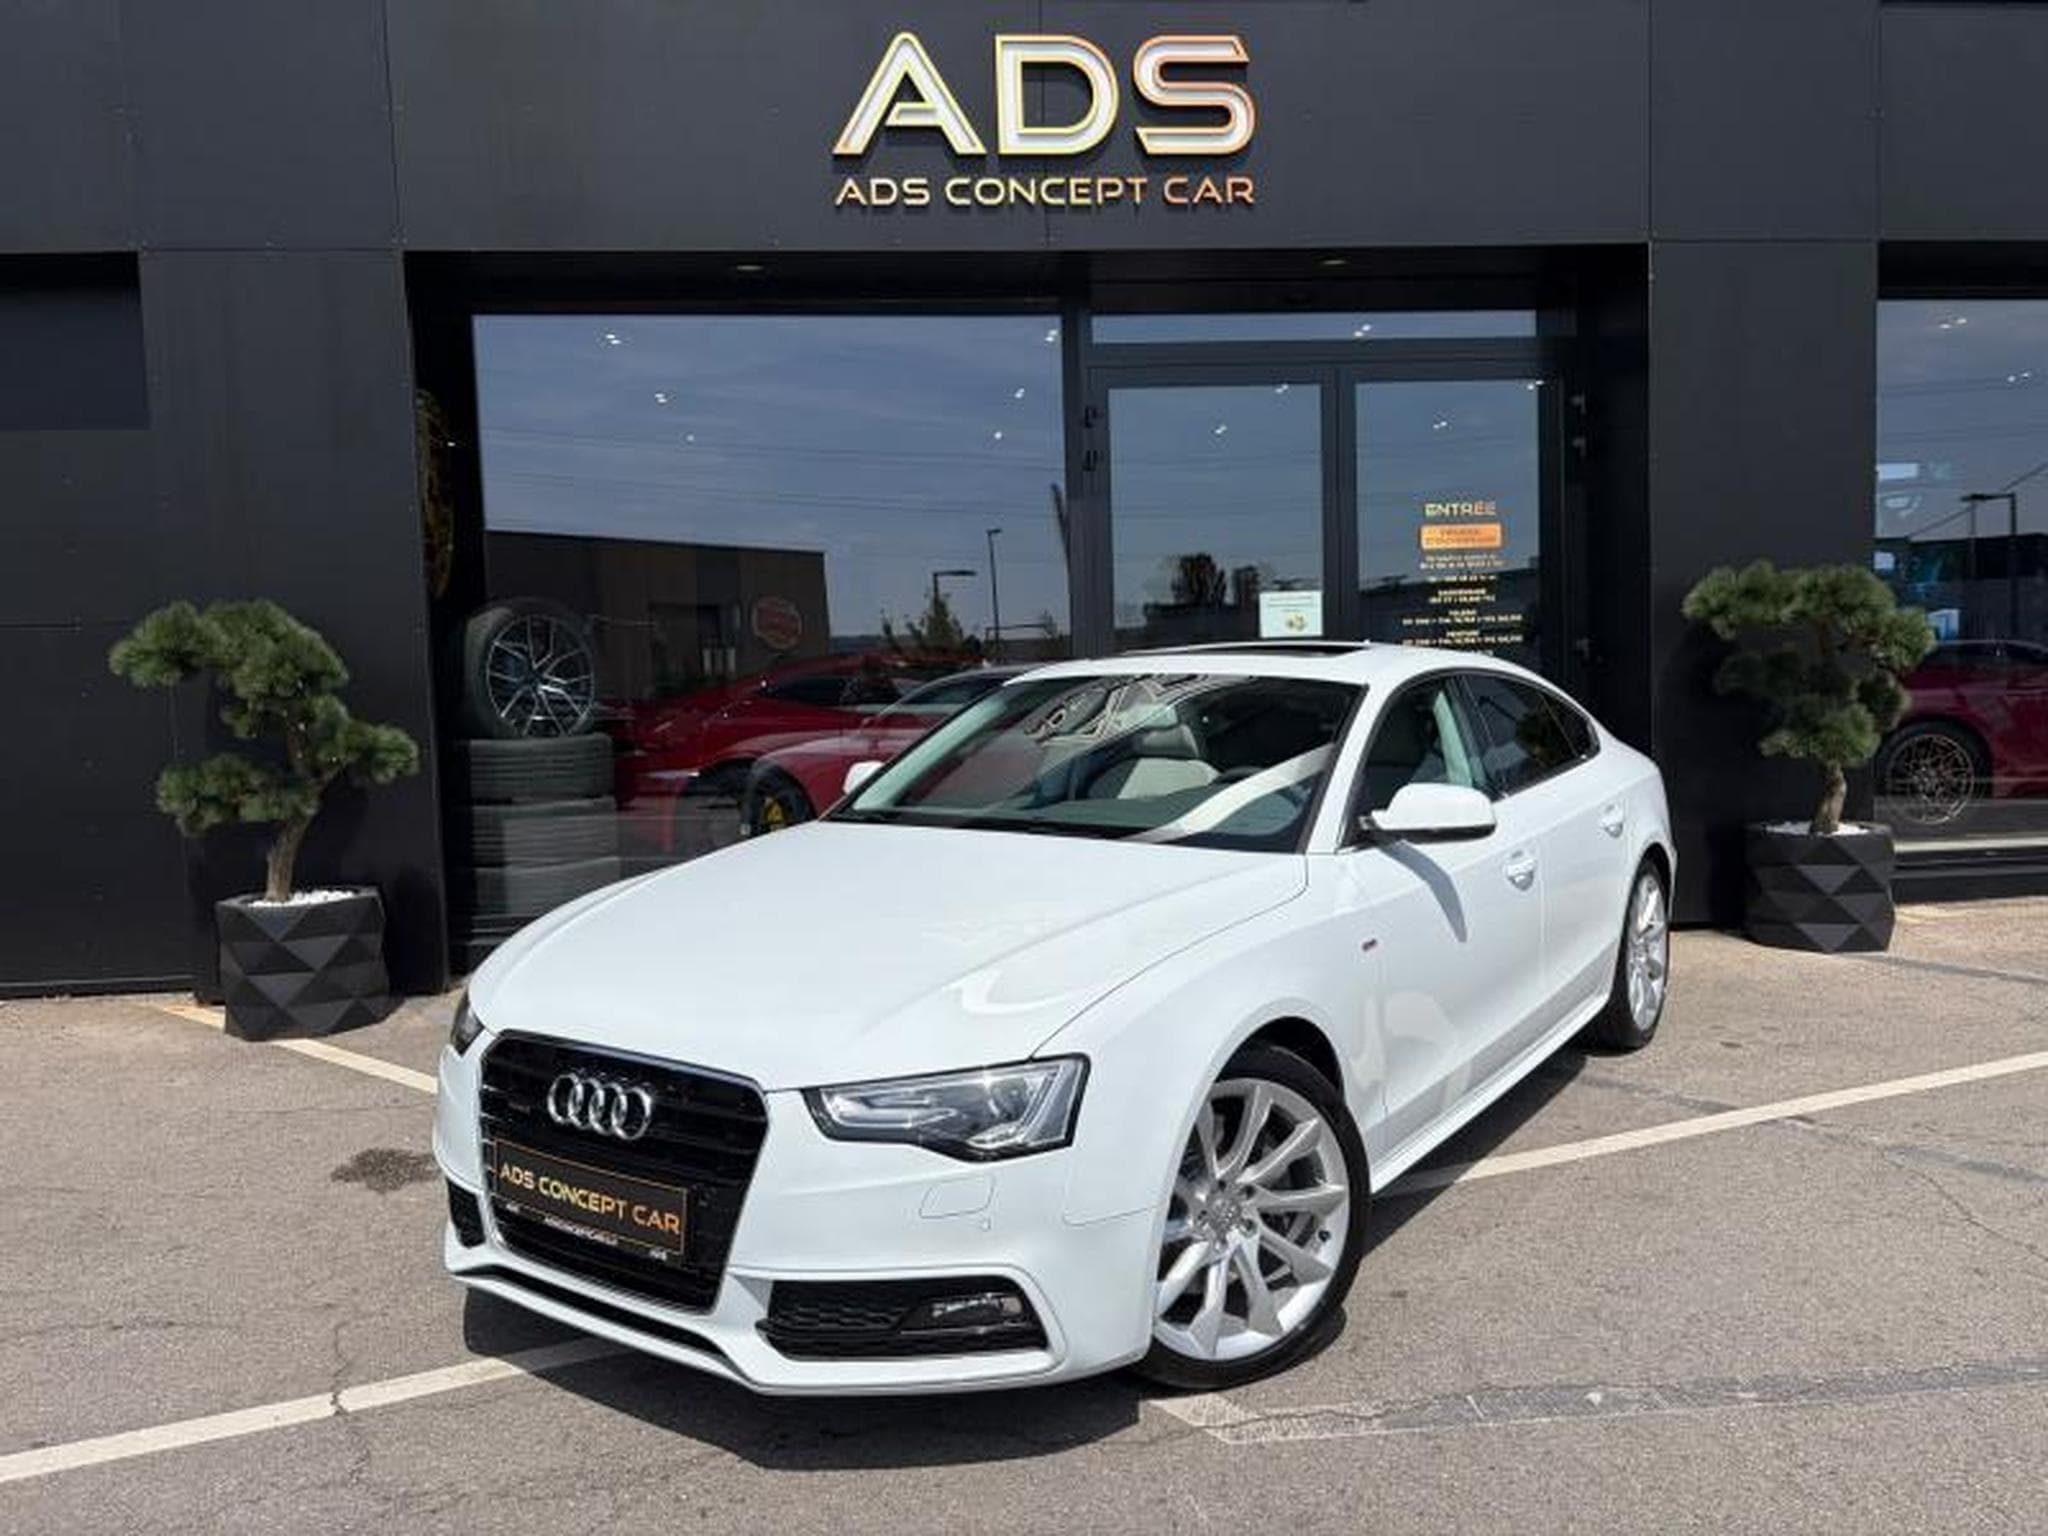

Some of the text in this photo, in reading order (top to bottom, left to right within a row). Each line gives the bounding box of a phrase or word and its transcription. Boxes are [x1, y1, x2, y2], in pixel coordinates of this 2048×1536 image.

[832, 32, 1256, 155] ADS
[834, 175, 1256, 206] ADS CONCEPT CAR
[500, 1161, 535, 1190] ADS
[538, 1176, 628, 1220] CONCEPT
[632, 1204, 681, 1235] CAR
